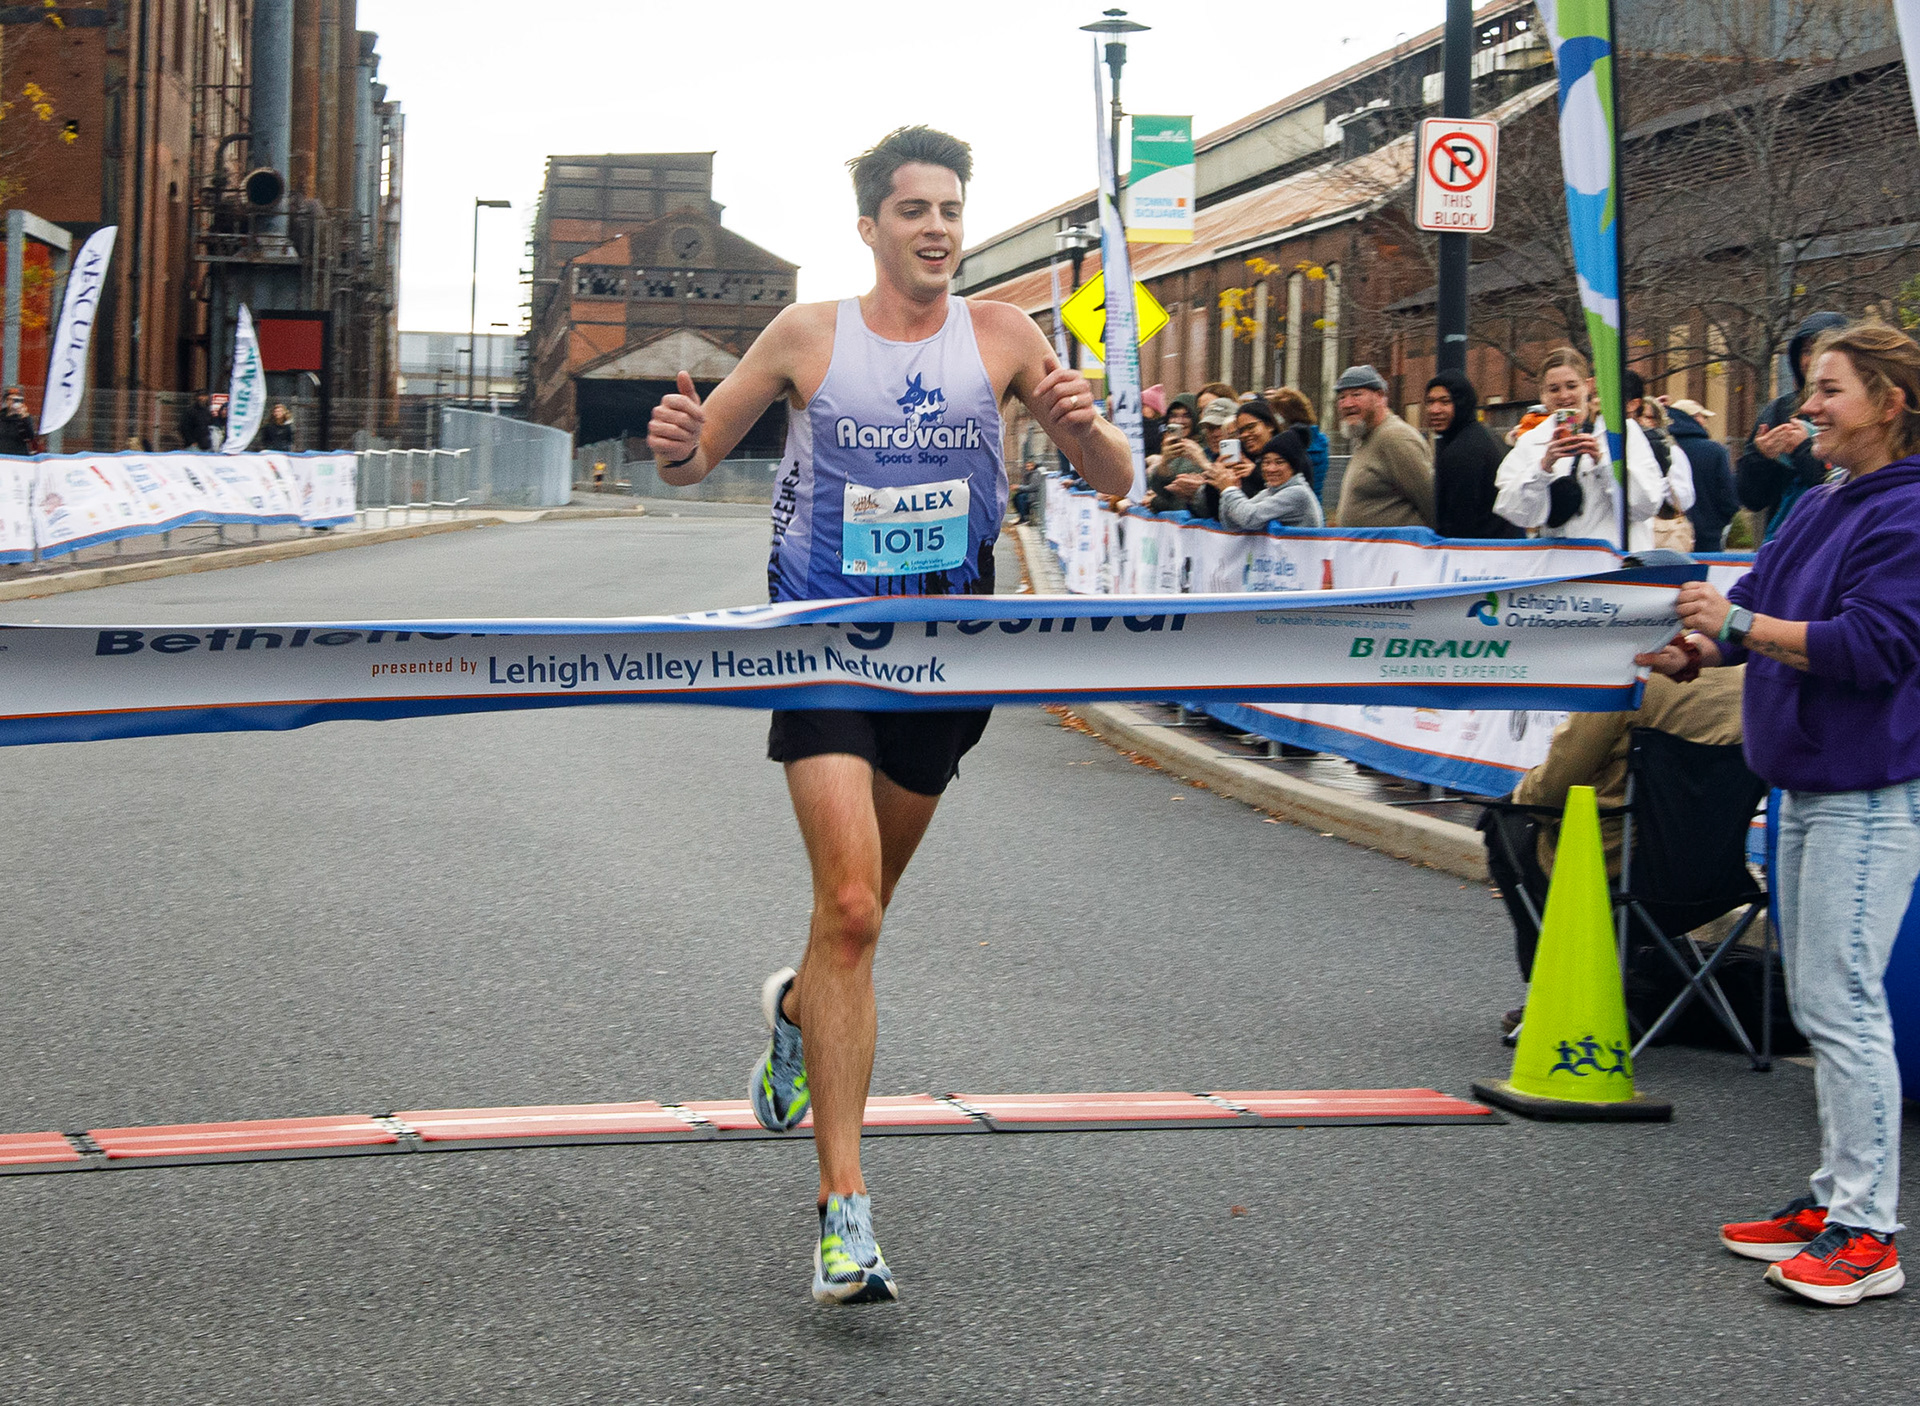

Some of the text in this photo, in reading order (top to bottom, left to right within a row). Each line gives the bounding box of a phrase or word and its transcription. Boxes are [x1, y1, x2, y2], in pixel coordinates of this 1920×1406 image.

[1442, 194, 1472, 208] THIS
[1134, 208, 1185, 218] SQUARE
[1434, 212, 1477, 226] BLOCK
[61, 249, 101, 400] AESCULAP
[836, 416, 981, 450] Aardvark
[875, 451, 948, 467] Sports Shop
[893, 490, 953, 513] ALEX
[870, 526, 945, 554] 1015
[1508, 593, 1623, 617] Lehigh Valley
[1255, 616, 1278, 624] Your
[1278, 617, 1313, 625] health
[1505, 613, 1678, 629] Orthopedic Institute
[1350, 637, 1511, 658] B BRAUN
[371, 645, 946, 688] presented by Lehigh Valley Health Network
[1380, 664, 1528, 678] SHARING EXPERTISE
